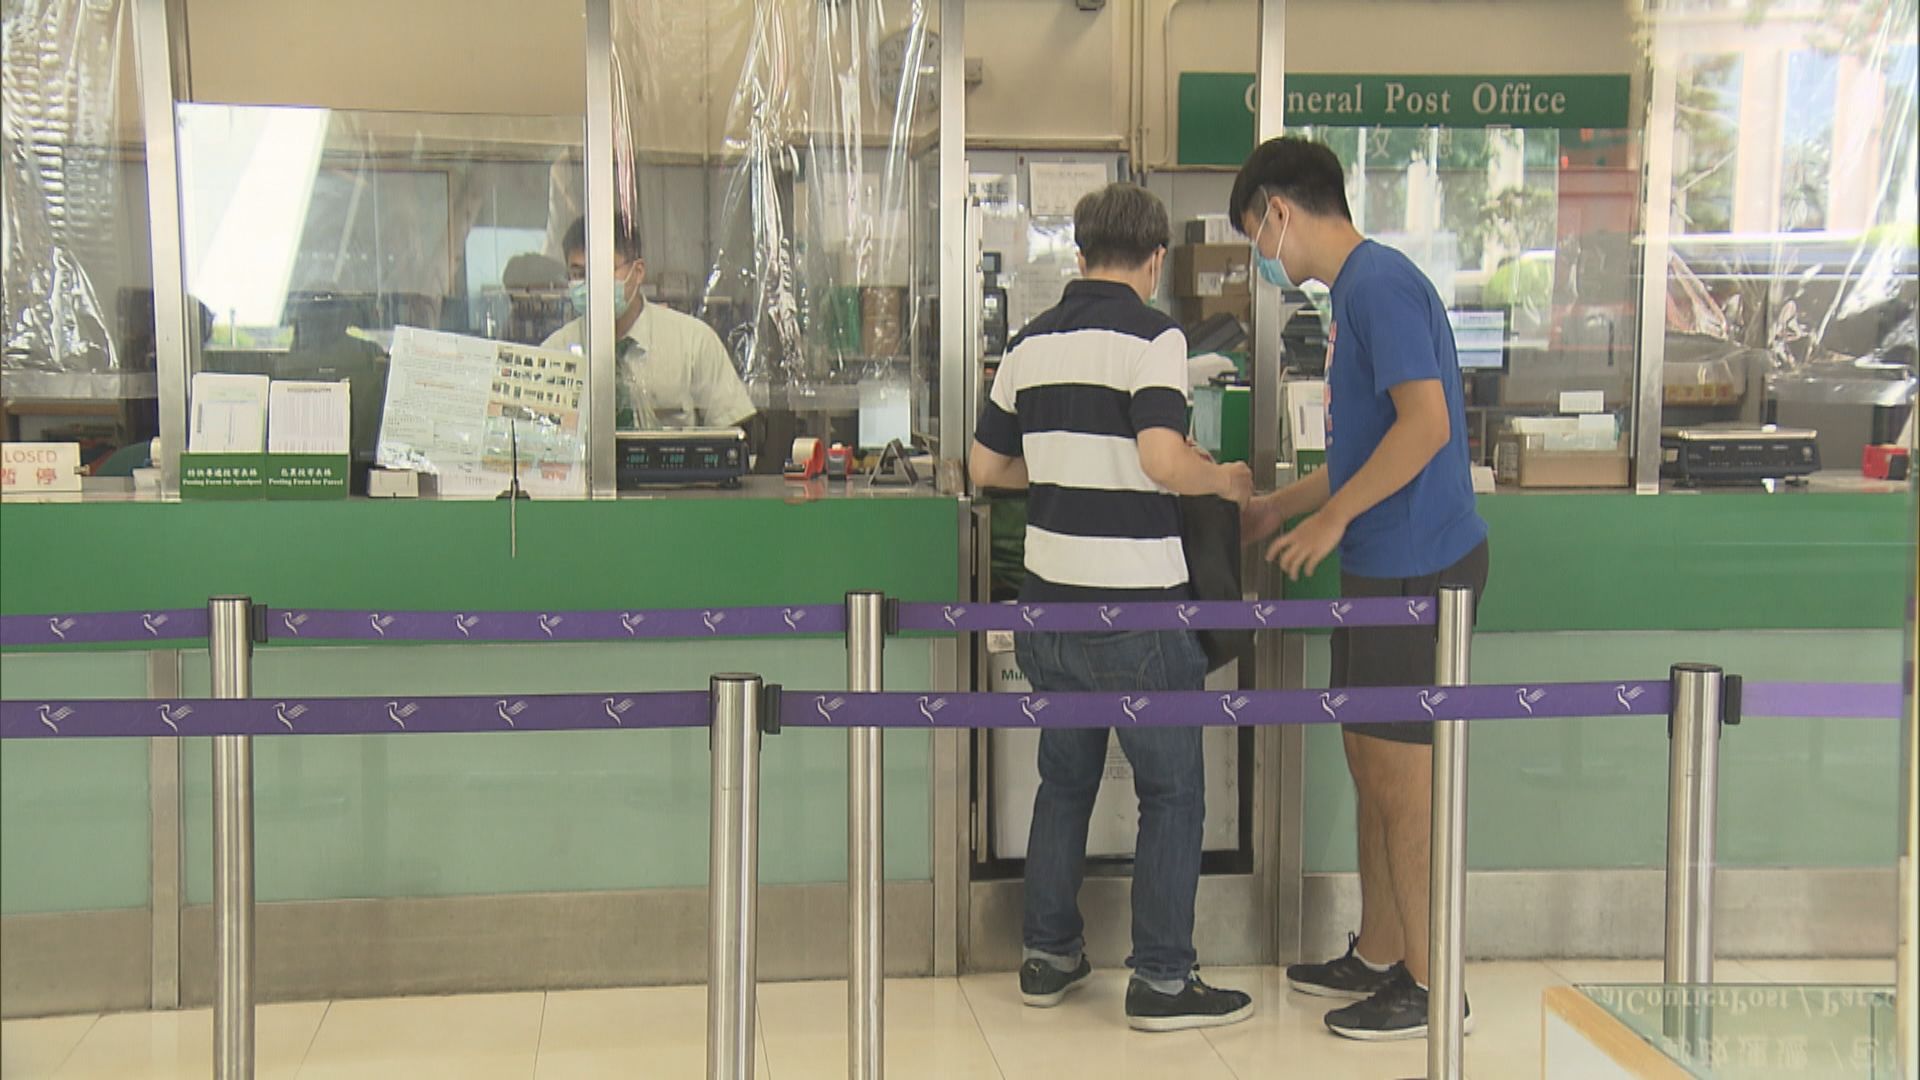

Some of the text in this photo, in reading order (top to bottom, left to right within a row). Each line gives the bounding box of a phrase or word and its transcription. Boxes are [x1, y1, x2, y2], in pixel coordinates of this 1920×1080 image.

[1244, 81, 1567, 115] neral Post Office
[3, 449, 58, 464] LOSED
